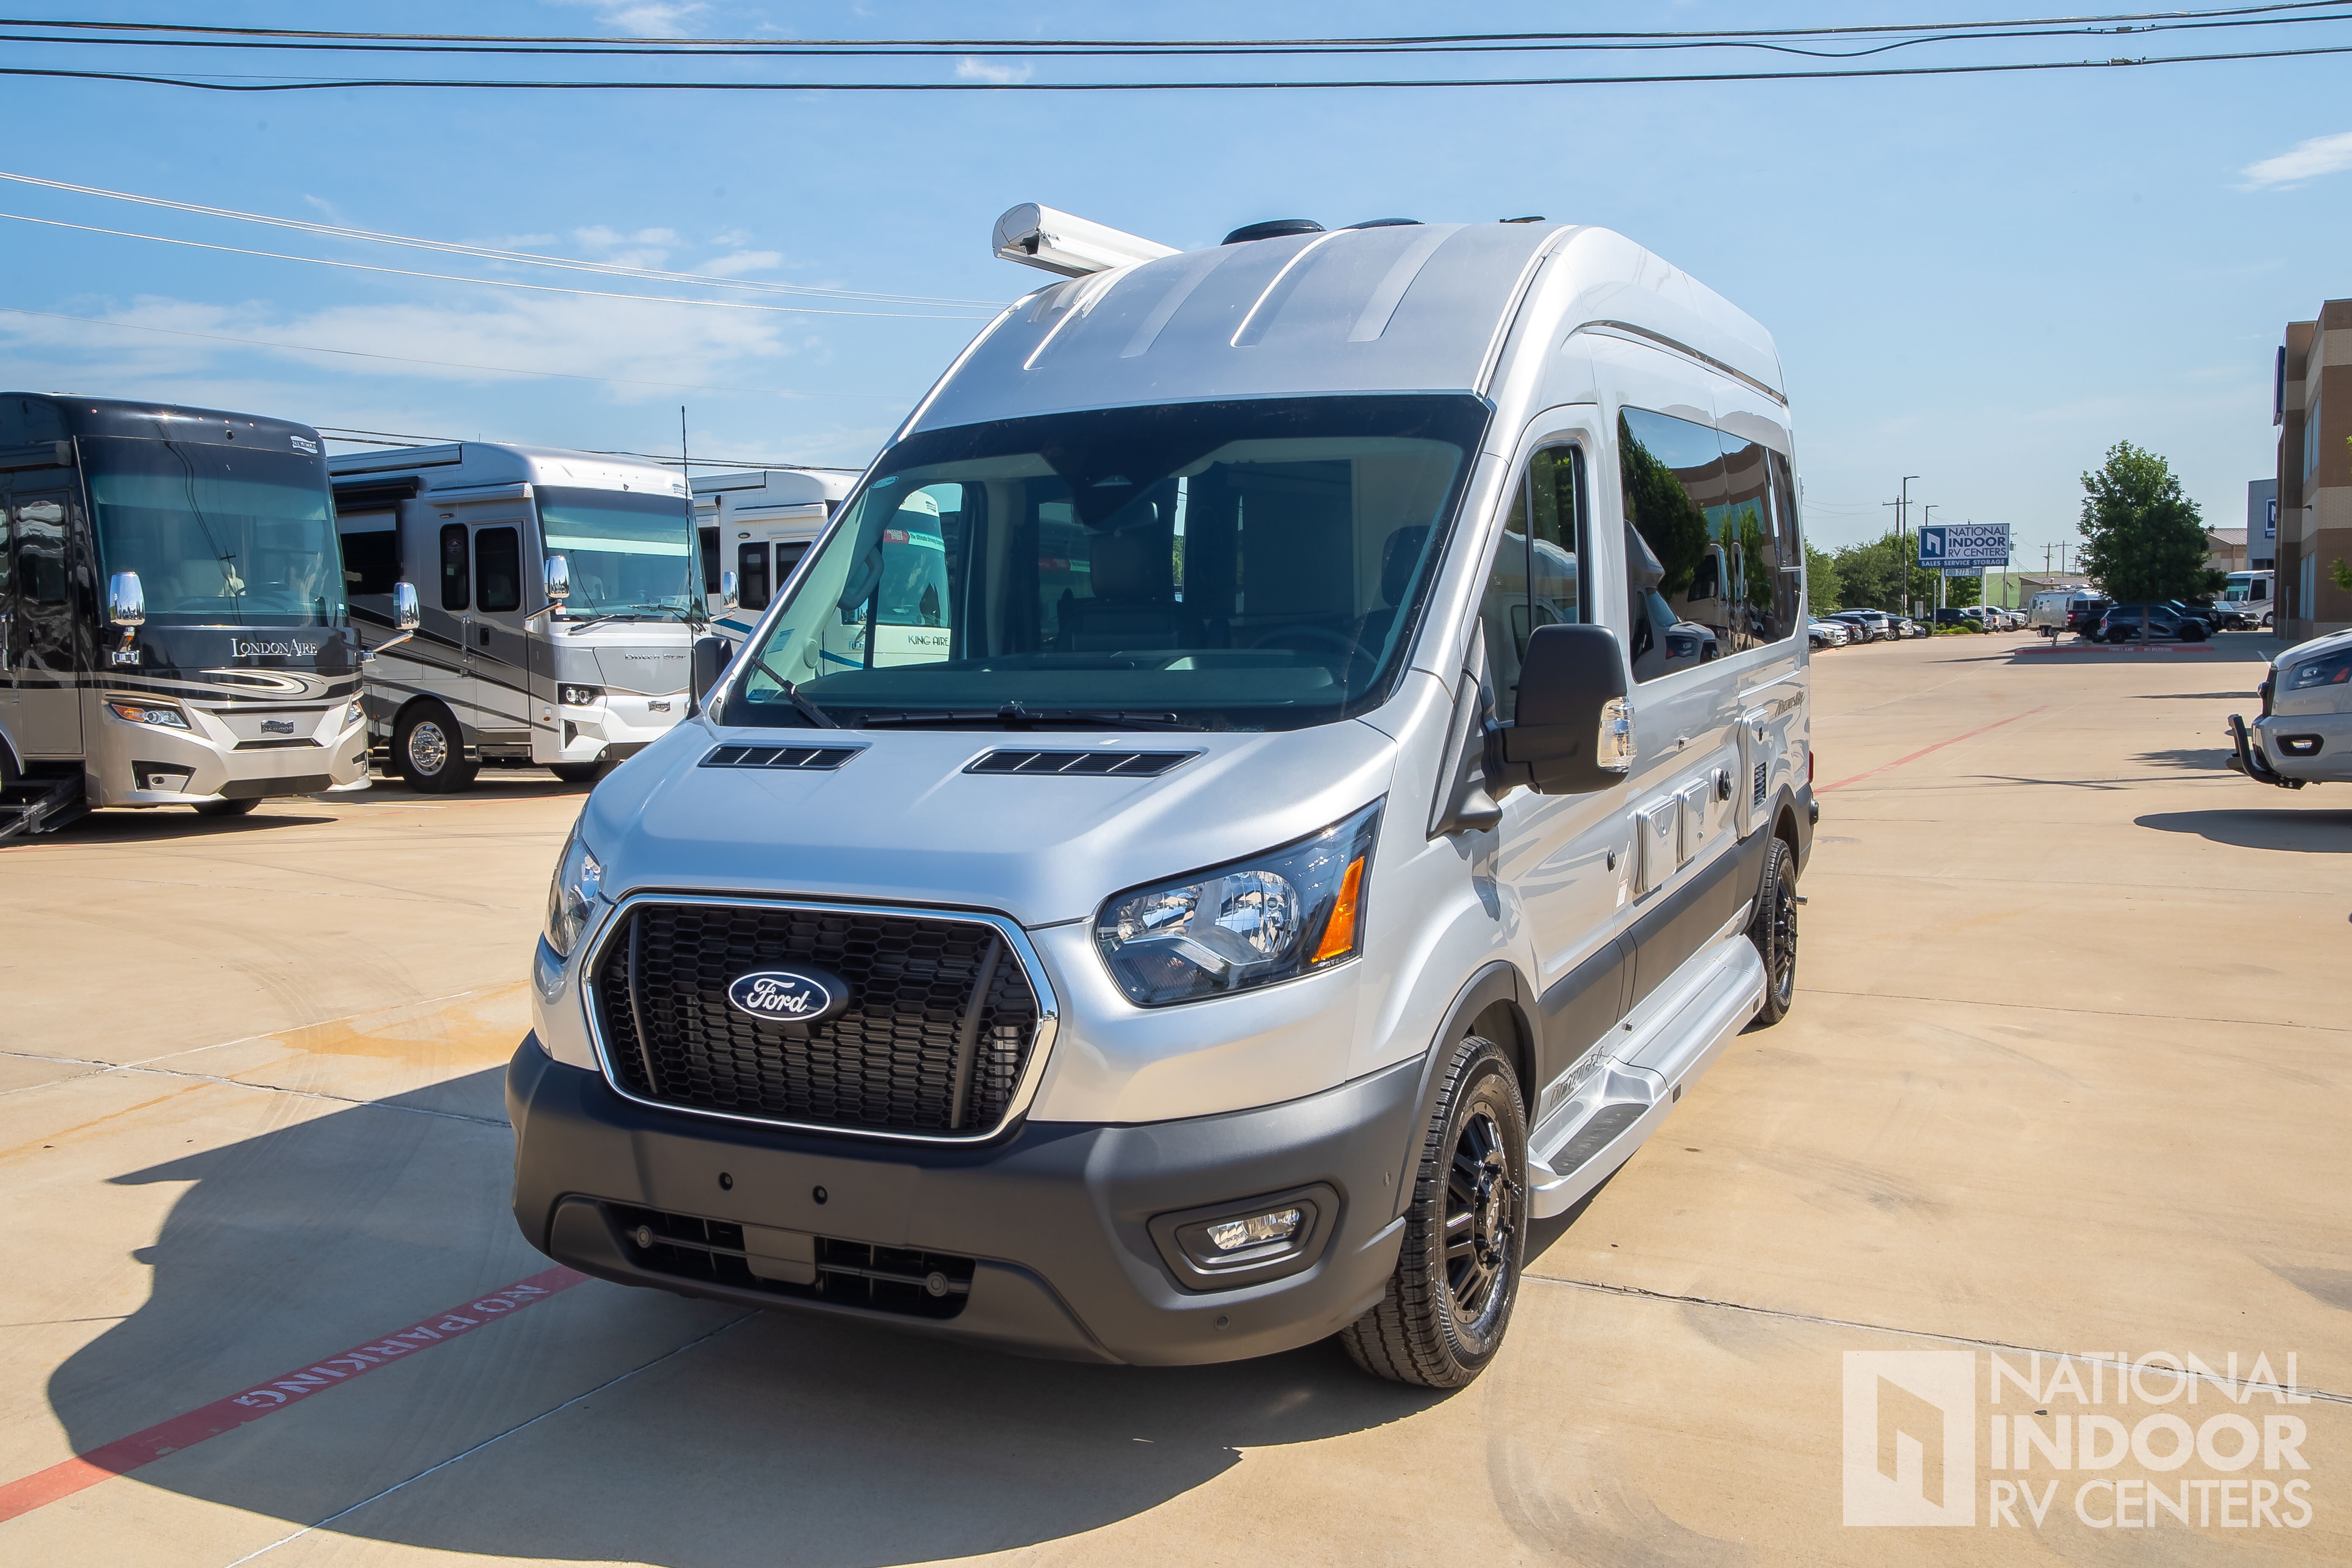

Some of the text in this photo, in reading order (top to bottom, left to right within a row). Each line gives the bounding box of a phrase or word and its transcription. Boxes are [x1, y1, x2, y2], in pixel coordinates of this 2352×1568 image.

[292, 440, 316, 449] NEWMAR
[1949, 526, 2006, 537] NATIONAL
[1949, 536, 2006, 547] INDOOR
[1948, 547, 2006, 557] RV CENTERS
[908, 635, 949, 646] KING AIRE
[747, 978, 810, 1013] Ford
[233, 1284, 549, 1408] NO PARKING
